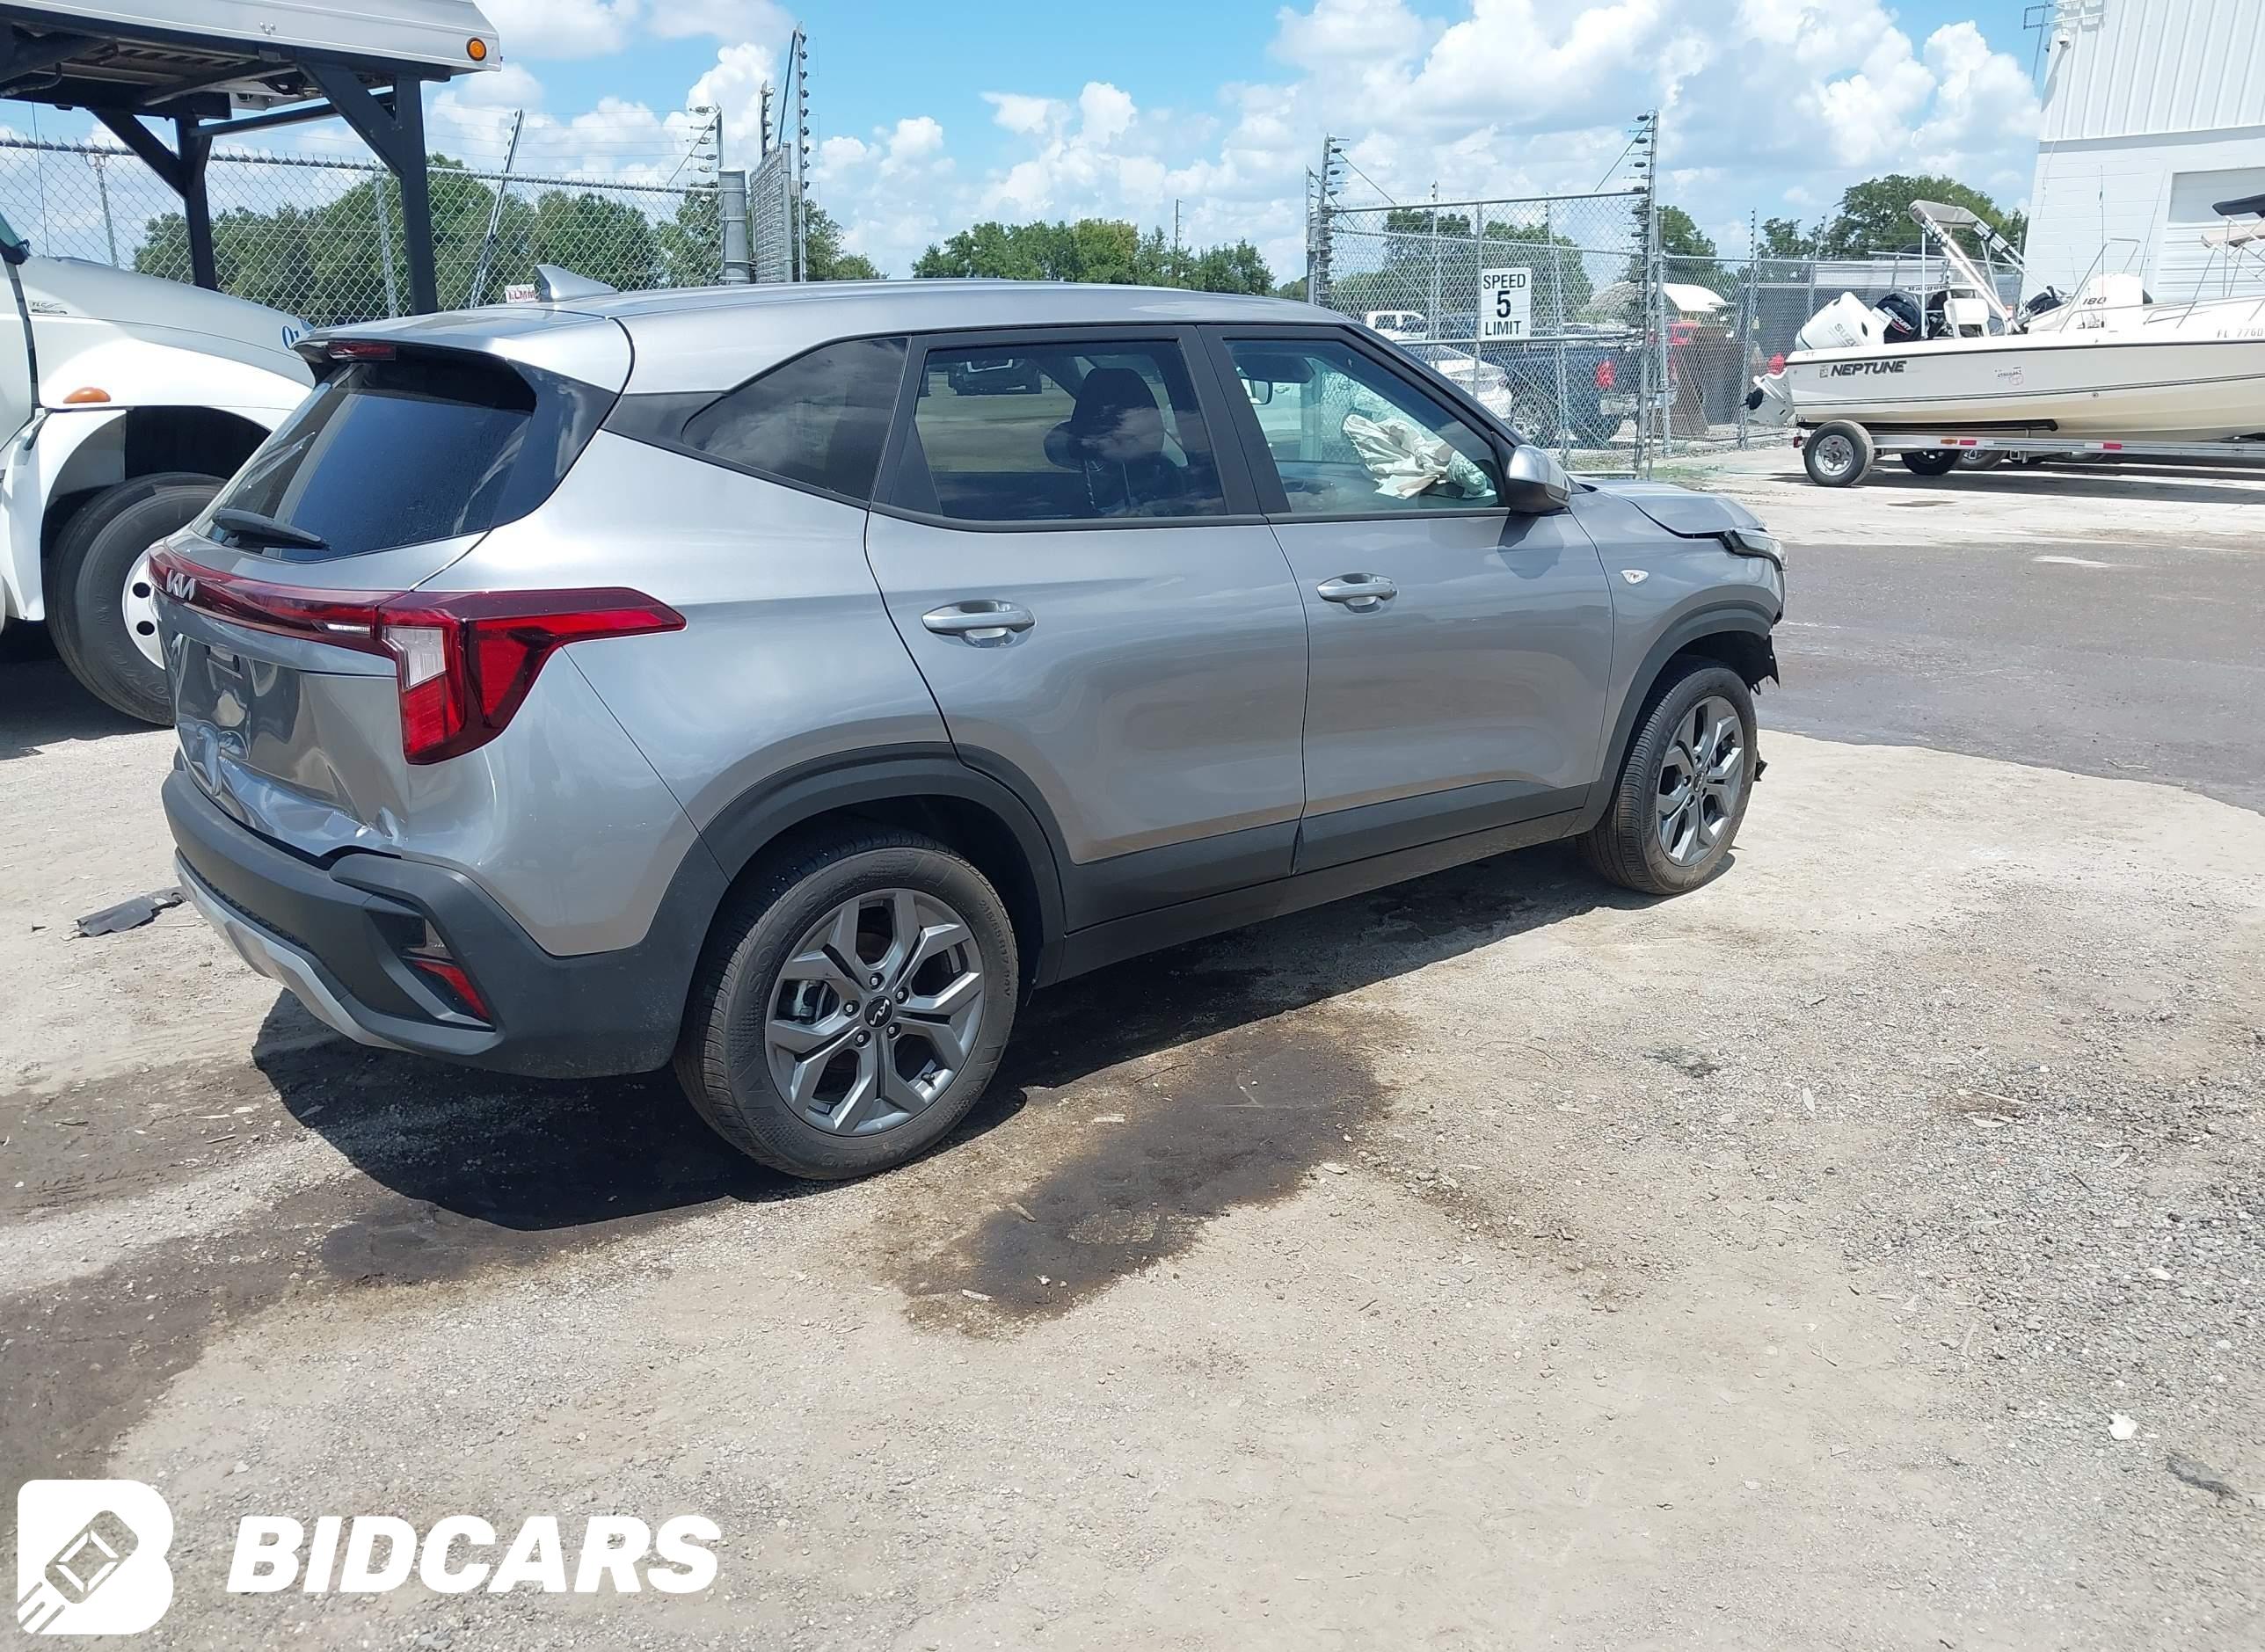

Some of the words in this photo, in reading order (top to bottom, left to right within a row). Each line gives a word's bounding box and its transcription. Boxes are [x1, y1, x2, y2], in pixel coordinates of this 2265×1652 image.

[1482, 273, 1526, 289] SPEED
[1497, 290, 1511, 318] 5
[2082, 296, 2107, 305] 180
[1485, 320, 1522, 336] LIMIT
[1831, 360, 1906, 377] NEPTUNE
